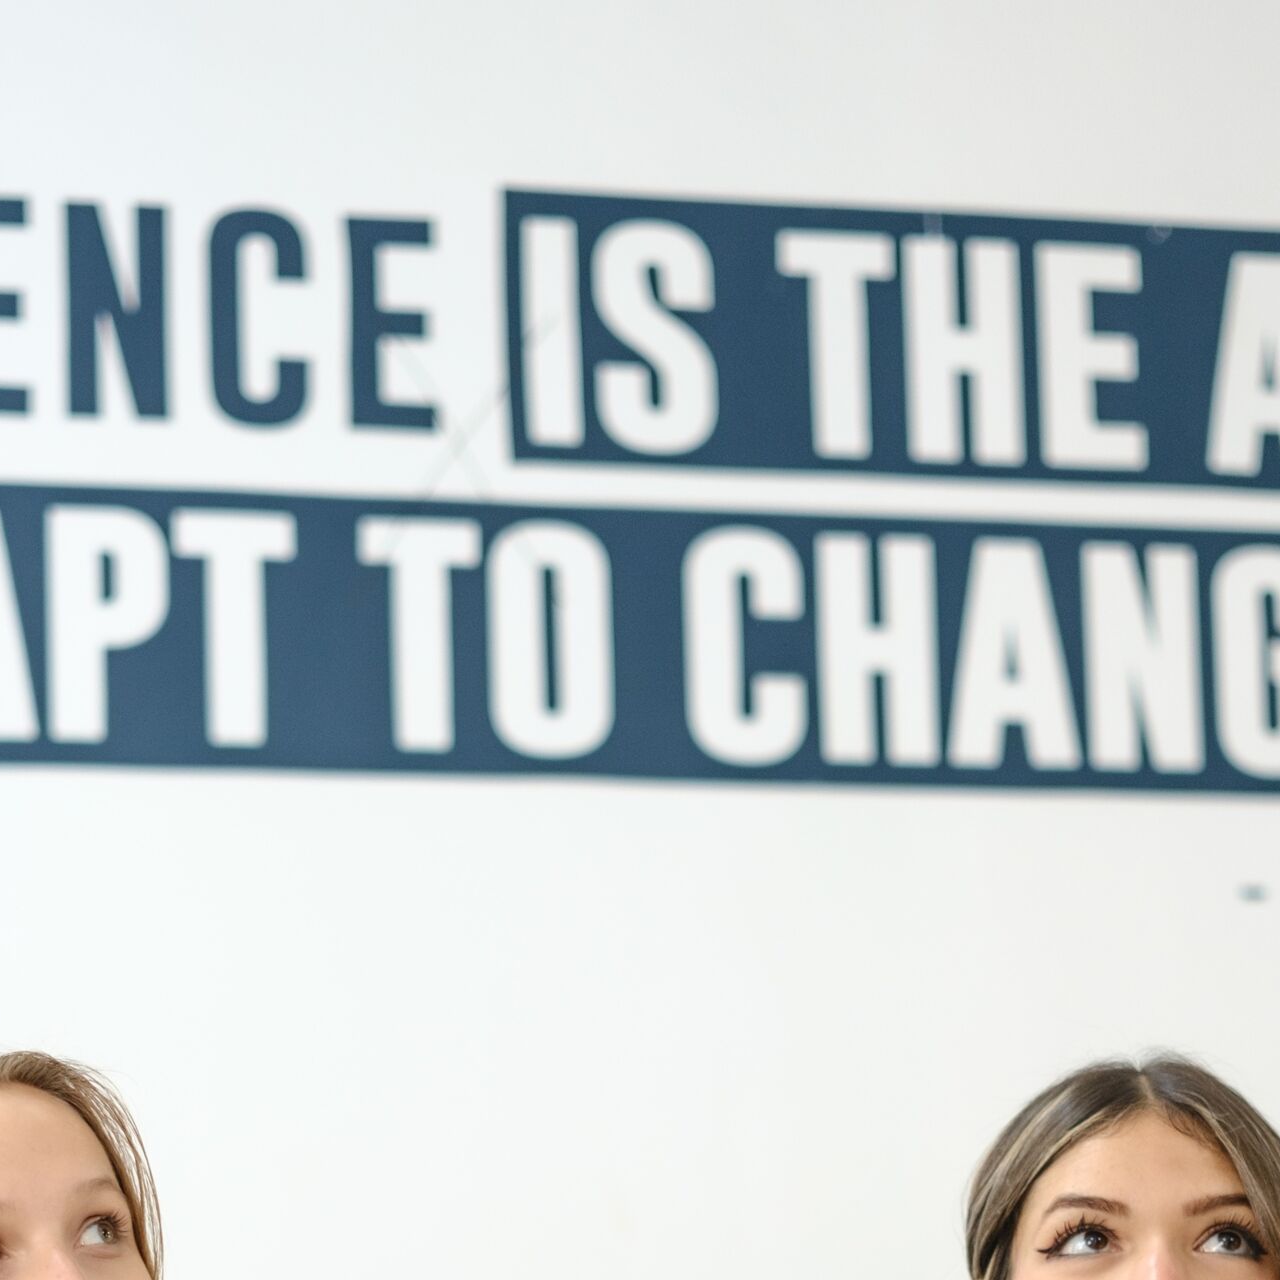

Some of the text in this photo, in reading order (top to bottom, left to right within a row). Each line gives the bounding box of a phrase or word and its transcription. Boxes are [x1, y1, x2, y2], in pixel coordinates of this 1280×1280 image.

[520, 215, 722, 458] IS
[776, 230, 1150, 470] THE
[356, 516, 617, 760] TO
